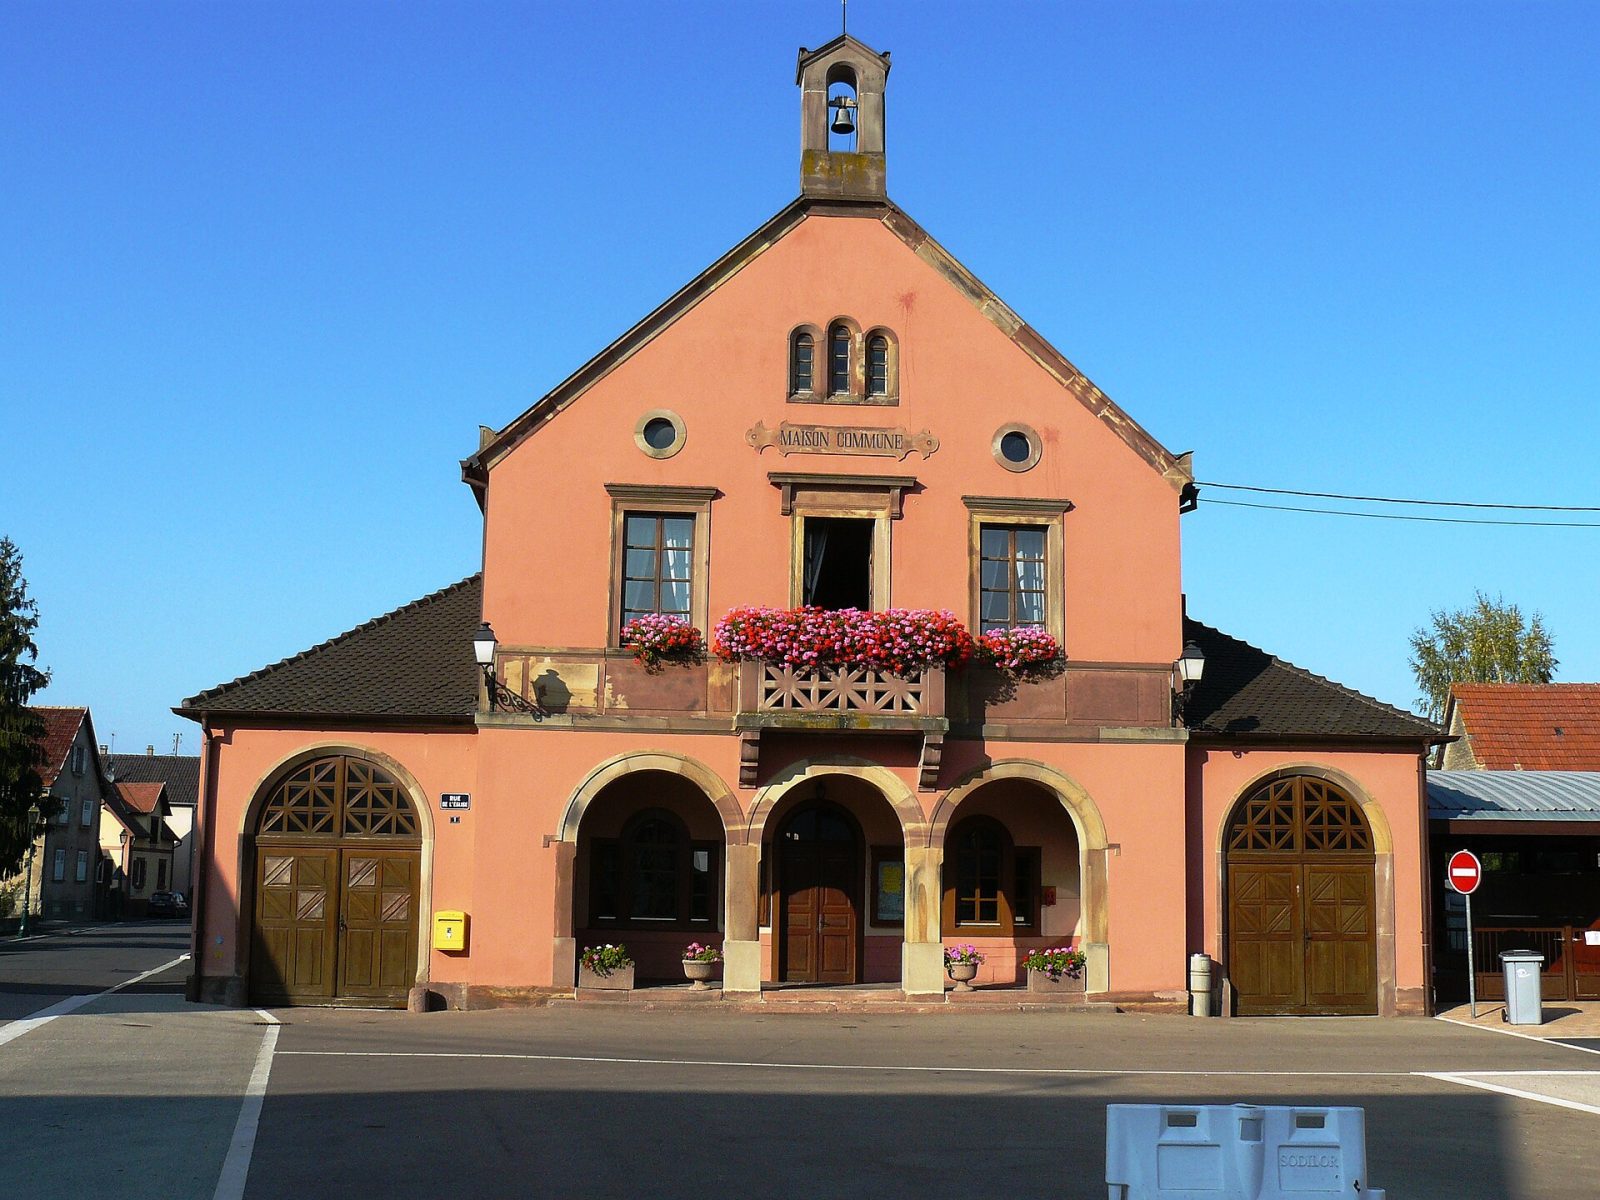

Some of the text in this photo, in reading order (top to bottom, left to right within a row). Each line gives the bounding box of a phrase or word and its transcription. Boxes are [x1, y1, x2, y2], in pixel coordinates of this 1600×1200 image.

[780, 430, 903, 449] MAISON COMMUNE
[1280, 1155, 1339, 1168] SODILOR
